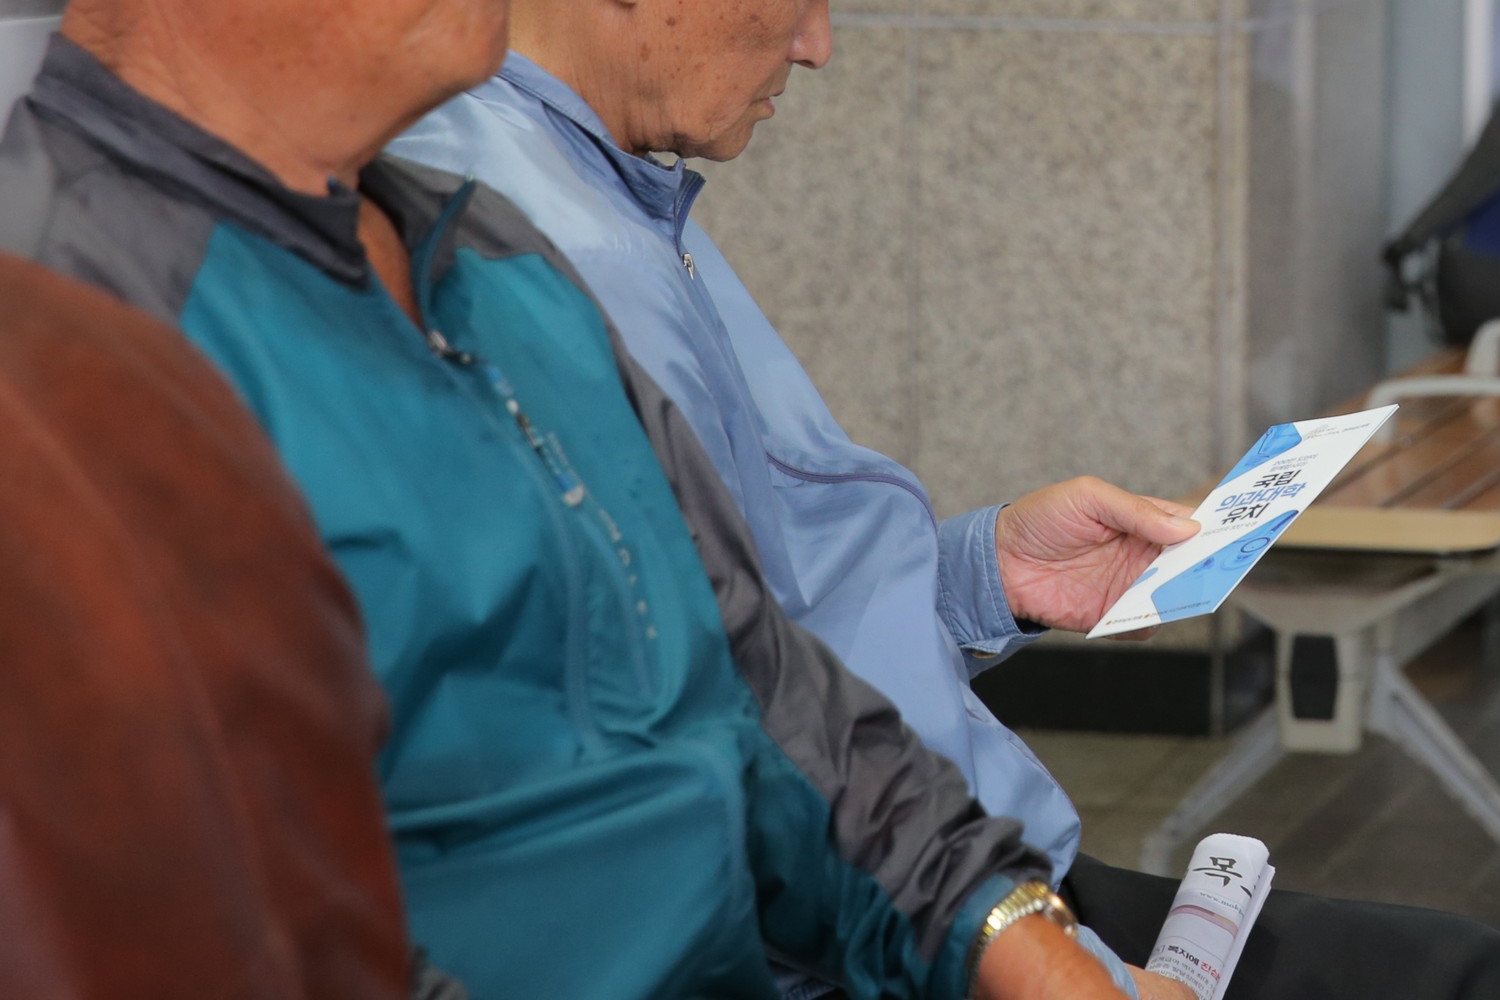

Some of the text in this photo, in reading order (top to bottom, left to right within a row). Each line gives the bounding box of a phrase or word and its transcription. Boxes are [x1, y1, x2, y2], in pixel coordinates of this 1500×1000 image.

[1253, 470, 1301, 488] 국립
[1215, 482, 1307, 512] 의과대학
[1221, 503, 1270, 525] 유치
